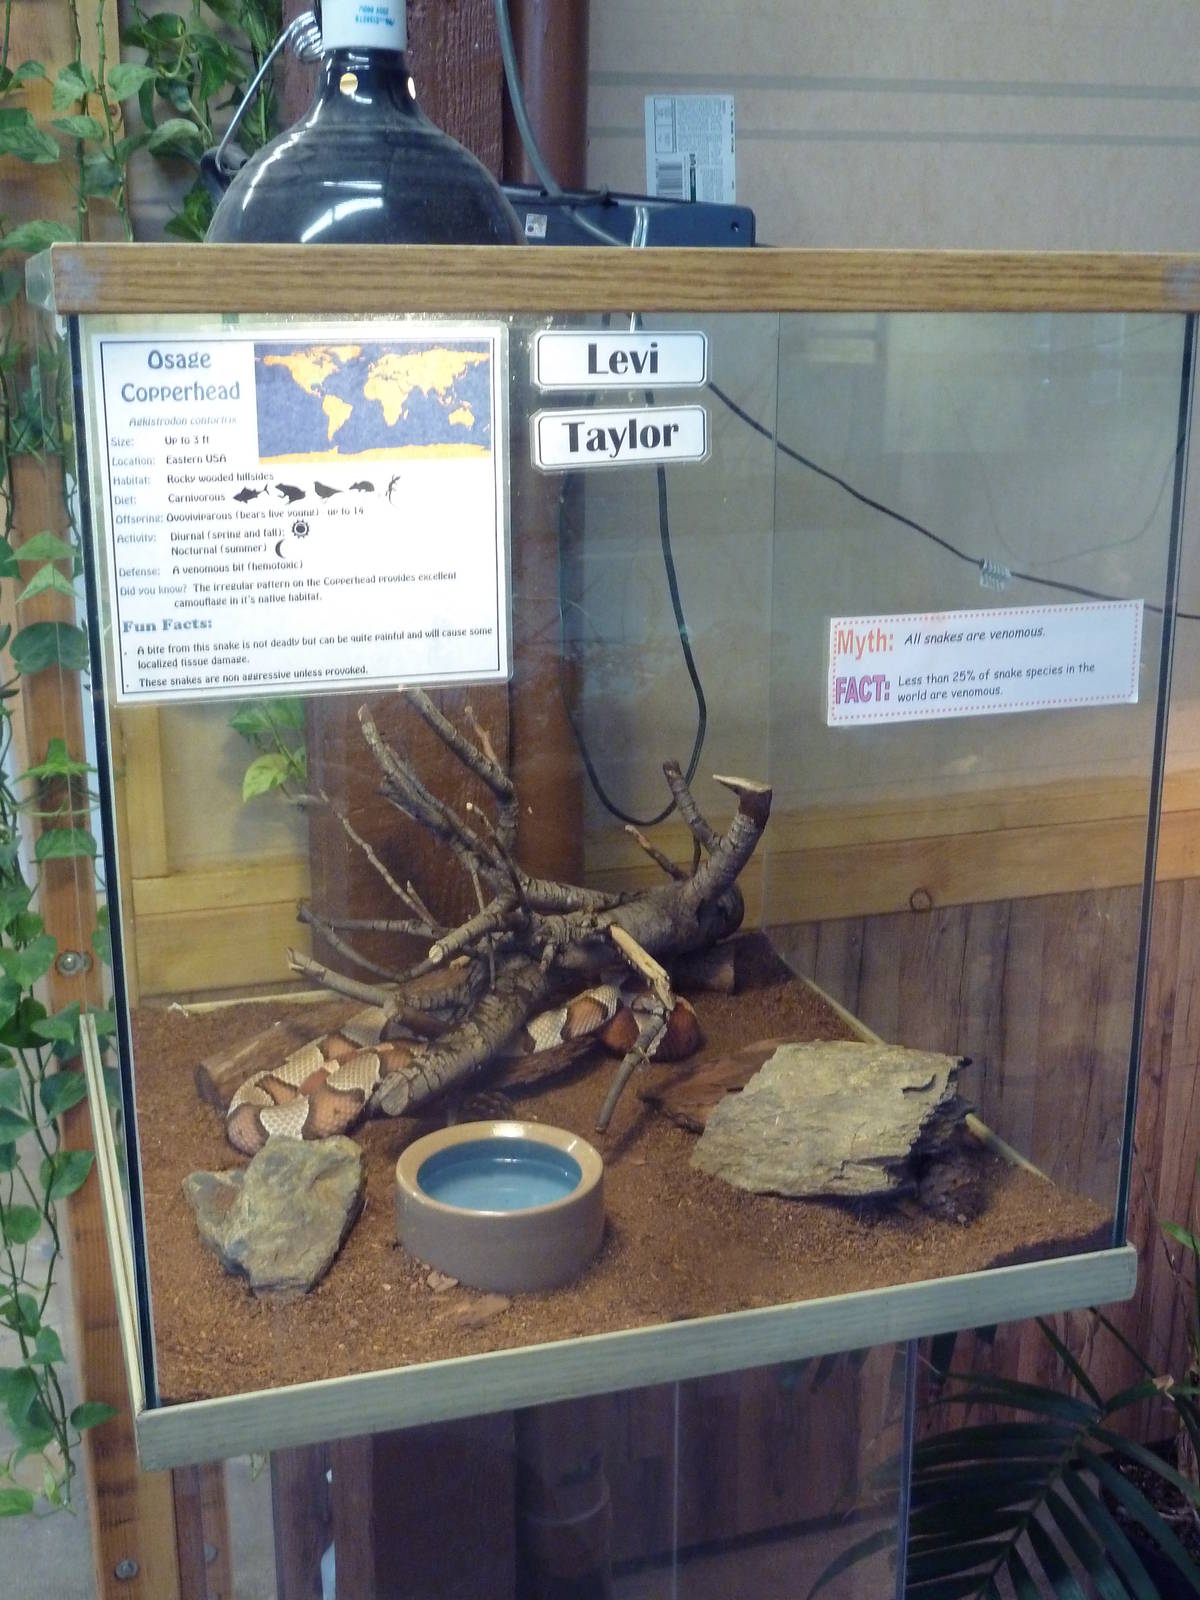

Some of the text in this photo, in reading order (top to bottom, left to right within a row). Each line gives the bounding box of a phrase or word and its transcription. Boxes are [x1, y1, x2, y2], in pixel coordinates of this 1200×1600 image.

[147, 350, 212, 369] Osage
[588, 342, 658, 374] Levi
[121, 382, 241, 402] Copperhead
[111, 435, 209, 447] Size: Up to 3 ft
[562, 419, 679, 458] Taylor
[112, 455, 227, 466] Location: Eastern USA
[113, 472, 274, 485] Habitat: Rocky wooded hillsides
[114, 492, 225, 505] Diet: Carnivorous
[116, 514, 164, 525] Offspring:
[236, 509, 266, 520] (bears
[268, 508, 285, 518] live
[287, 507, 319, 518] young)
[327, 509, 339, 517] up
[341, 507, 350, 516] to
[354, 507, 364, 515] 14
[117, 533, 157, 544] Activity:
[170, 531, 205, 541] Diurnal
[207, 530, 241, 540] (spring
[244, 528, 261, 538] and
[171, 543, 267, 556] Nocturnal (summer)
[119, 560, 303, 577] Defense: A venomous bit (hemotoxic)
[120, 572, 457, 596] Did you know? The irregular pattern on the Copperhead provides excellent
[174, 592, 322, 608] camouflage in it's native habitat.
[123, 618, 213, 633] Fun Facts:
[137, 627, 492, 655] A bite from this snake is not deadly but can be quite painful and will cause some
[837, 627, 894, 661] Myth:
[904, 627, 1045, 645] All snakes are venomous.
[138, 655, 250, 669] localized tissue damage.
[139, 665, 368, 688] These snakes are non aggressive unless provoked.
[898, 662, 1095, 687] Less than 25% of snake species in the
[835, 674, 890, 704] FACT:
[897, 685, 1003, 703] world are venomous.
